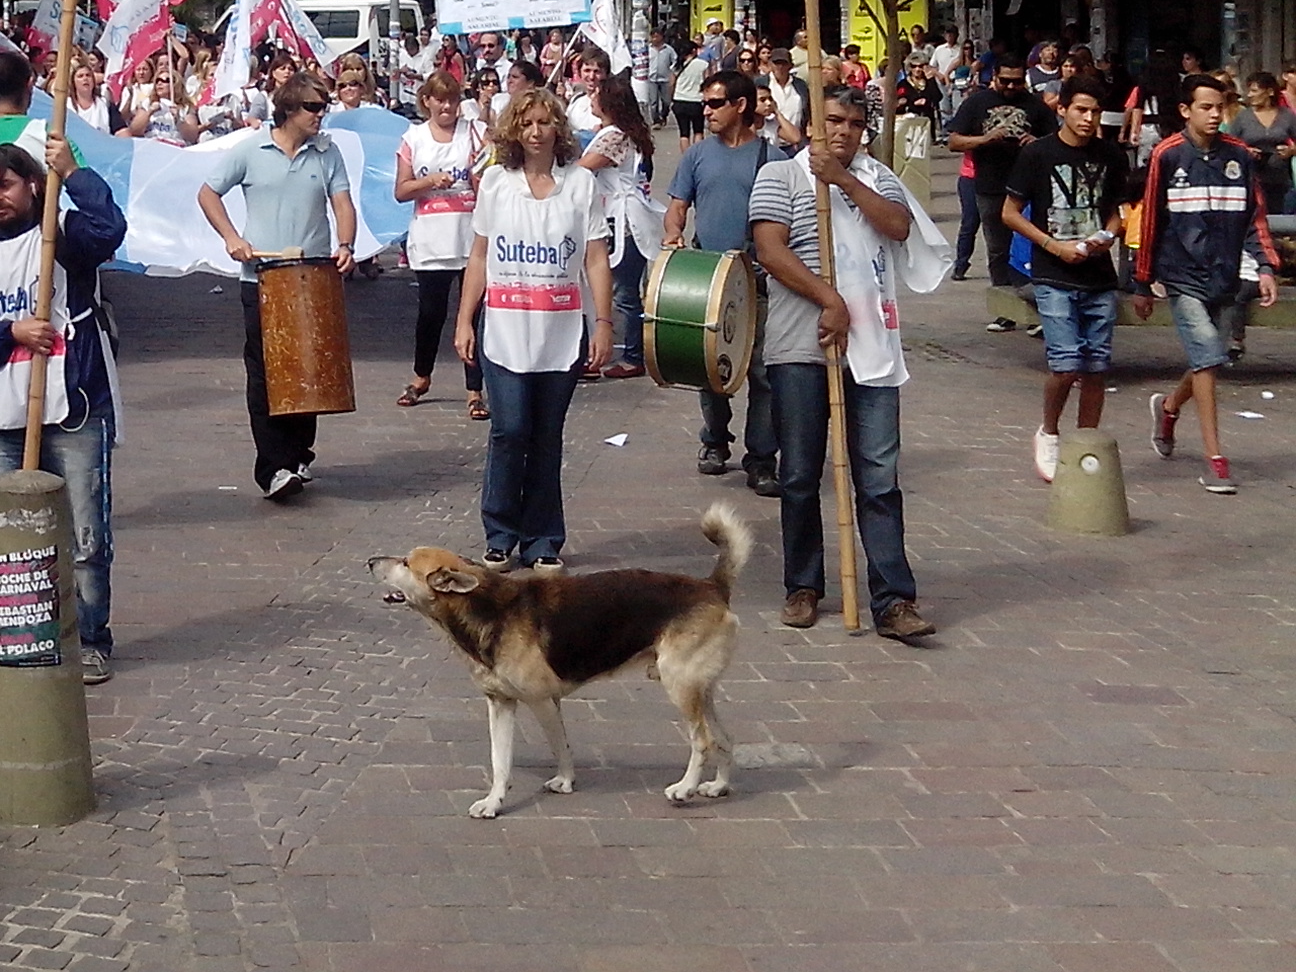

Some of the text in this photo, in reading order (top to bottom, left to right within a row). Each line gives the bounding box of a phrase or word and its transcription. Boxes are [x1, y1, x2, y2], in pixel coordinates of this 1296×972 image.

[496, 235, 557, 265] Suteba
[9, 546, 56, 562] BLOQUE
[33, 570, 48, 581] DE
[6, 640, 54, 656] POLACO
